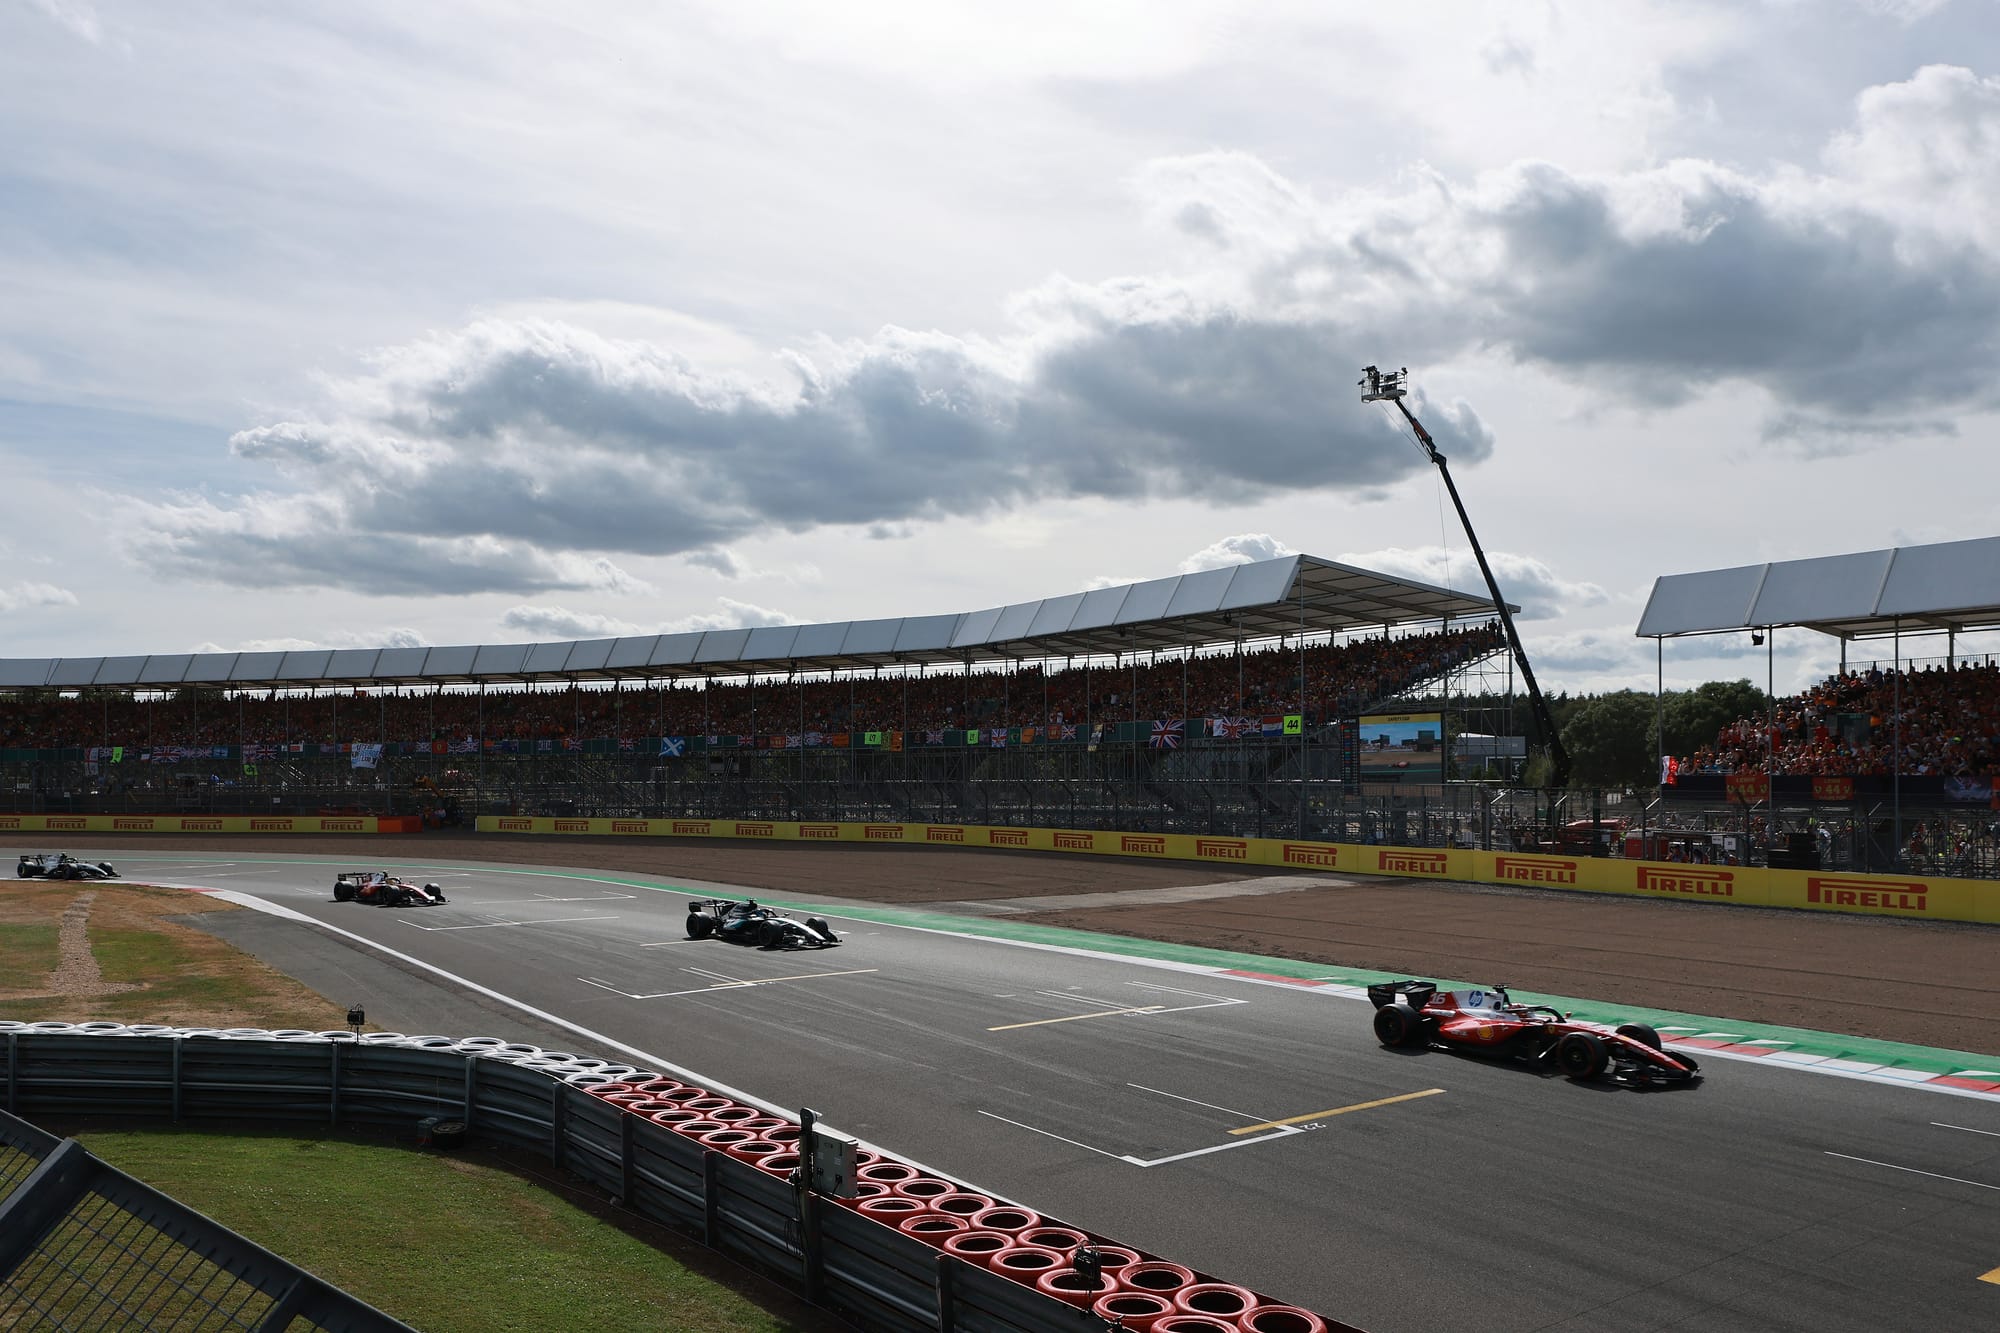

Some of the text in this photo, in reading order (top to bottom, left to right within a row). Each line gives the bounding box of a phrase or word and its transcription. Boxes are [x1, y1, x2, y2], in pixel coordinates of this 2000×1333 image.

[1286, 719, 1299, 730] 44
[1738, 784, 1756, 794] 44
[46, 818, 86, 829] PIRELLI
[113, 818, 154, 830] PIRELLI
[181, 819, 223, 831] PIRELLI
[250, 819, 293, 831] PIRELLI
[320, 819, 363, 831] PIRELLI
[498, 818, 532, 830] PIRELLI
[554, 819, 589, 832] PIRELLI
[611, 820, 648, 833] PIRELLI
[672, 821, 711, 835] PIRELLI
[735, 823, 774, 837] PIRELLI
[800, 825, 838, 838] PIRELLI
[864, 825, 903, 839] PIRELLI
[926, 826, 964, 842] PIRELLI
[990, 829, 1028, 845] PIRELLI
[1053, 832, 1093, 850] PIRELLI
[1121, 836, 1165, 854] PIRELLI
[1196, 839, 1247, 859] PIRELLI
[1283, 844, 1337, 867] PIRELLI
[1379, 850, 1447, 874] PIRELLI
[1495, 856, 1577, 884] PIRELLI
[1637, 866, 1735, 897] PIRELLI
[1807, 877, 1928, 911] PIRELLI
[1429, 992, 1446, 1005] 16
[1469, 990, 1483, 1007] hp
